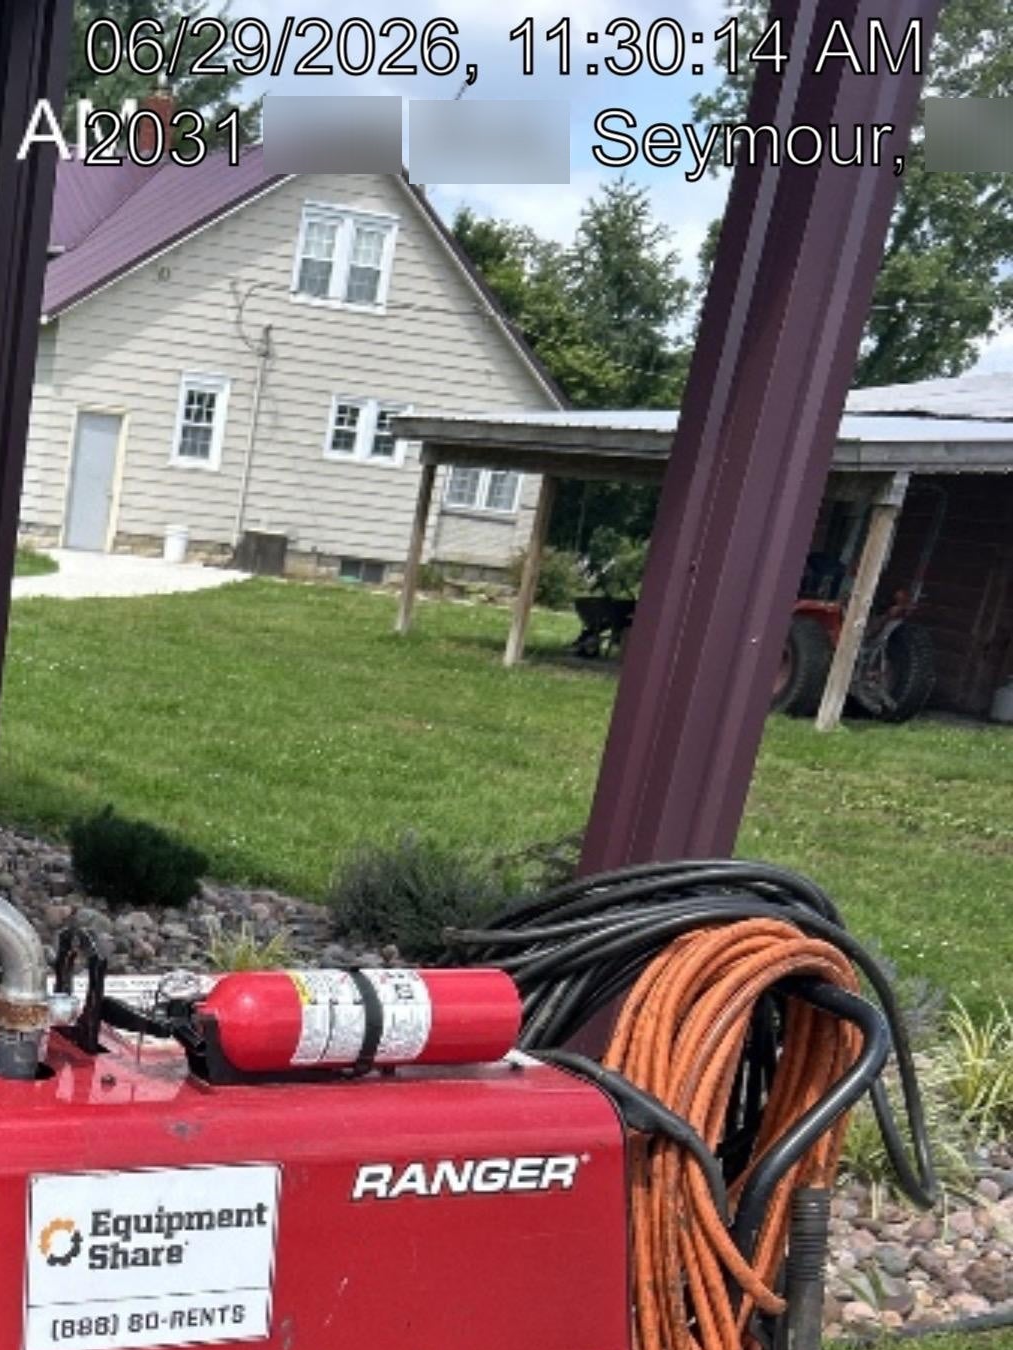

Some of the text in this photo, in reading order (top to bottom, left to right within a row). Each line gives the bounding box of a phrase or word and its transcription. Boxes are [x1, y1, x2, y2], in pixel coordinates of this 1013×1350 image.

[351, 1153, 580, 1200] RANGER
[89, 1203, 268, 1242] Equipment
[88, 1243, 184, 1270] Share
